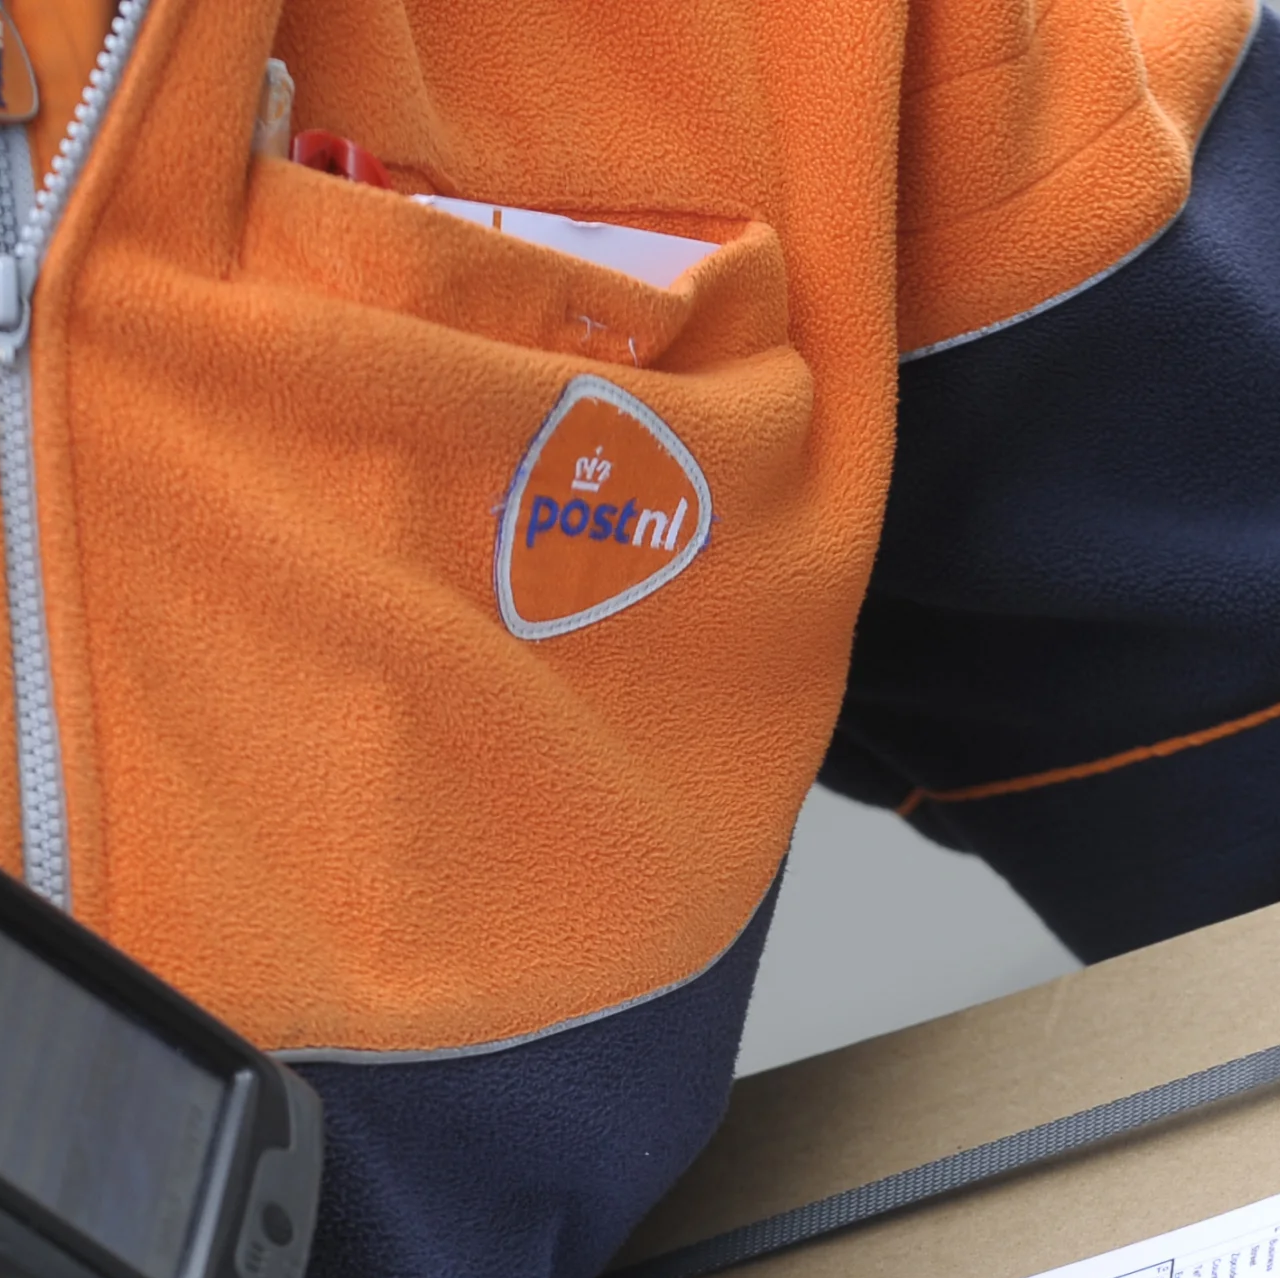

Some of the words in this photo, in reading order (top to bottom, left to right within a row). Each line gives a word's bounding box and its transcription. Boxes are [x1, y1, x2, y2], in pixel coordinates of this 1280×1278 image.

[526, 495, 687, 551] postnl
[1249, 1244, 1261, 1267] Street
[1265, 1237, 1279, 1273] Business
